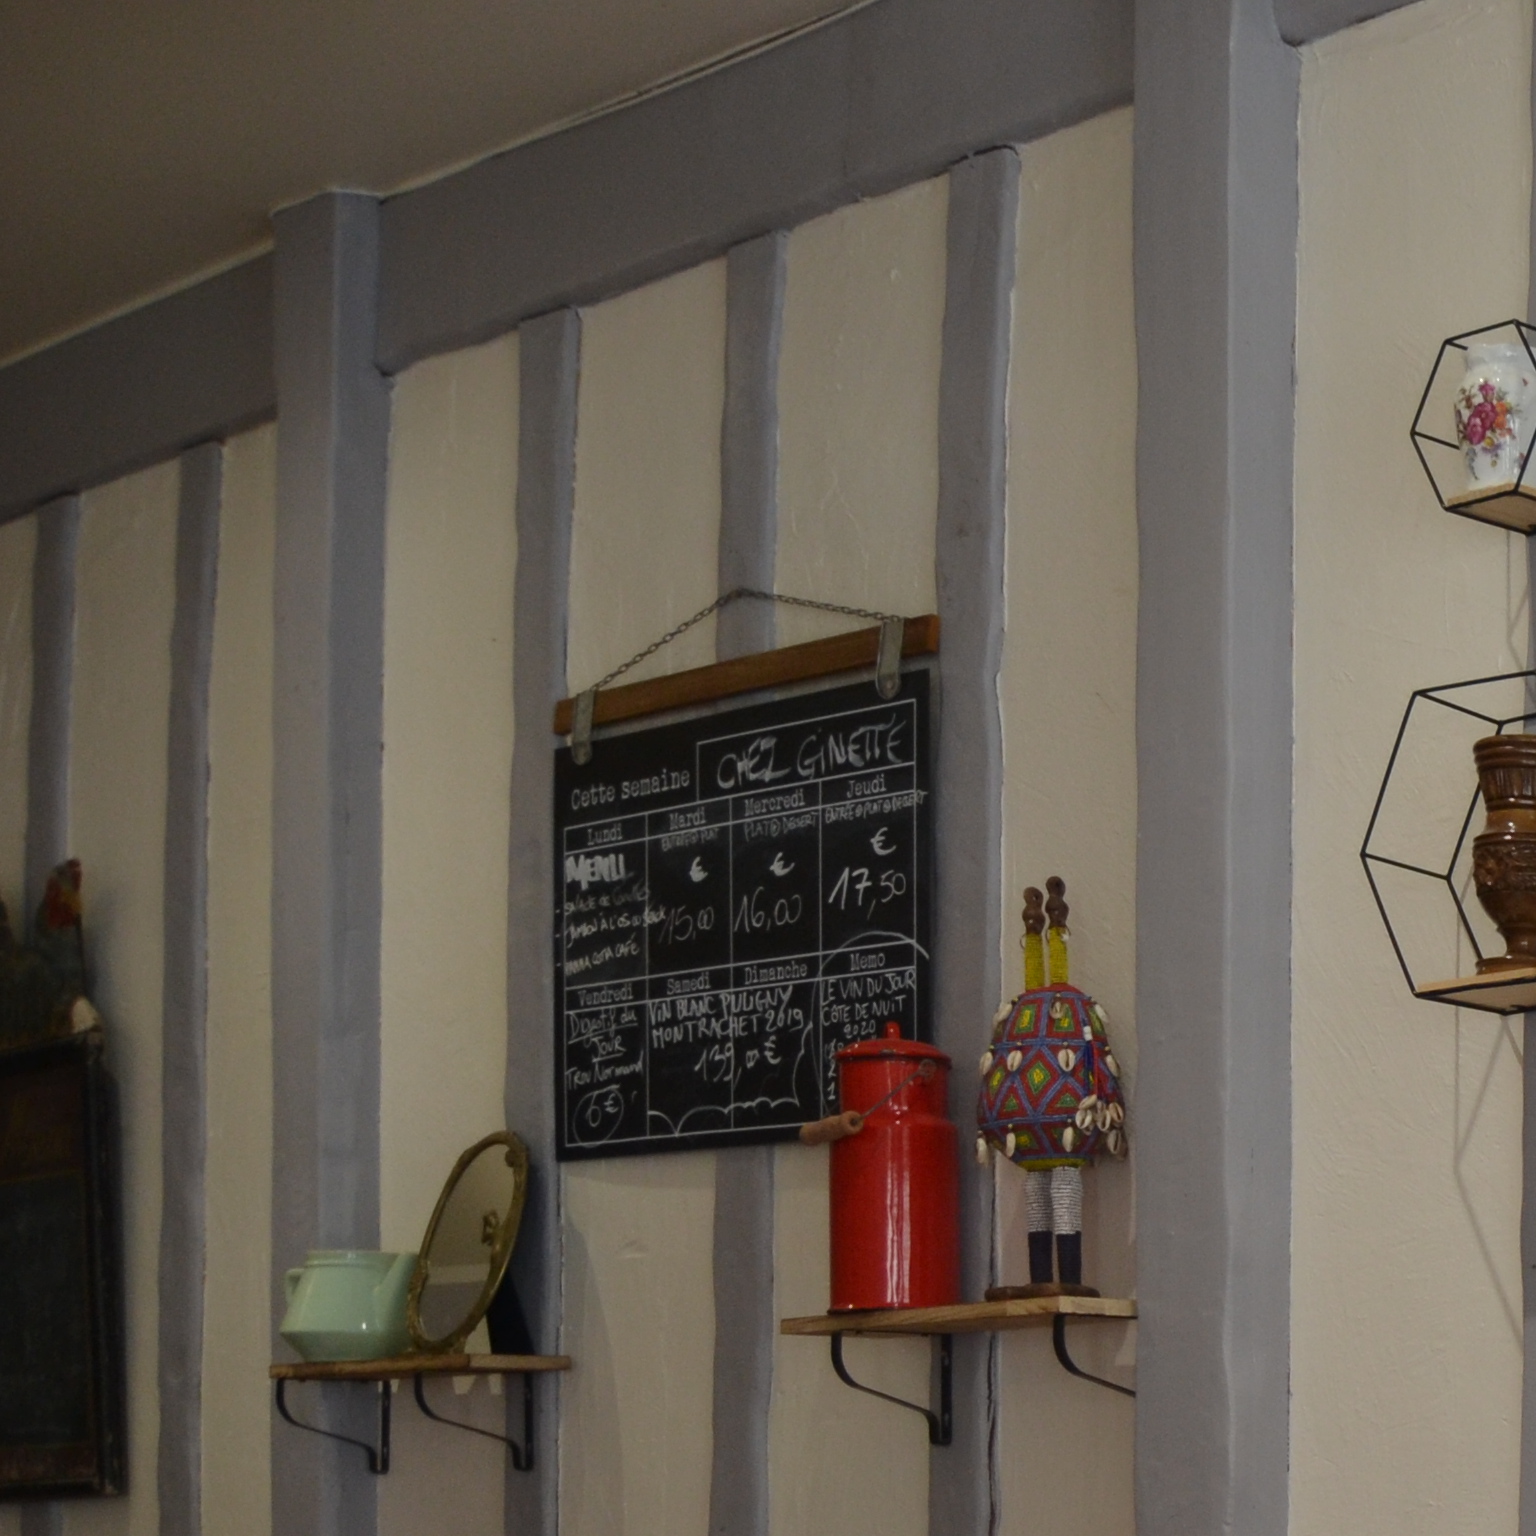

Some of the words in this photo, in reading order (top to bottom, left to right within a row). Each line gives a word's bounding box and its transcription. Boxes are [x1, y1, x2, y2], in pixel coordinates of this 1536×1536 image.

[717, 736, 792, 789] CHEZ
[571, 783, 616, 811] Cette
[621, 768, 690, 800] semaine
[846, 773, 887, 799] Jeudi
[744, 788, 806, 817] Mercredi
[669, 806, 707, 831] Mardi
[587, 823, 623, 846] Lundi
[827, 866, 907, 920] 17,50
[734, 886, 803, 934] 16,00
[744, 962, 808, 986] Dimanche
[849, 953, 886, 972] Memo
[577, 982, 634, 1008] Vendredi
[666, 971, 712, 996] Samedi
[866, 975, 883, 997] DU
[676, 995, 716, 1020] BLANC
[765, 1008, 804, 1033] 2019
[843, 1019, 876, 1039] 2020
